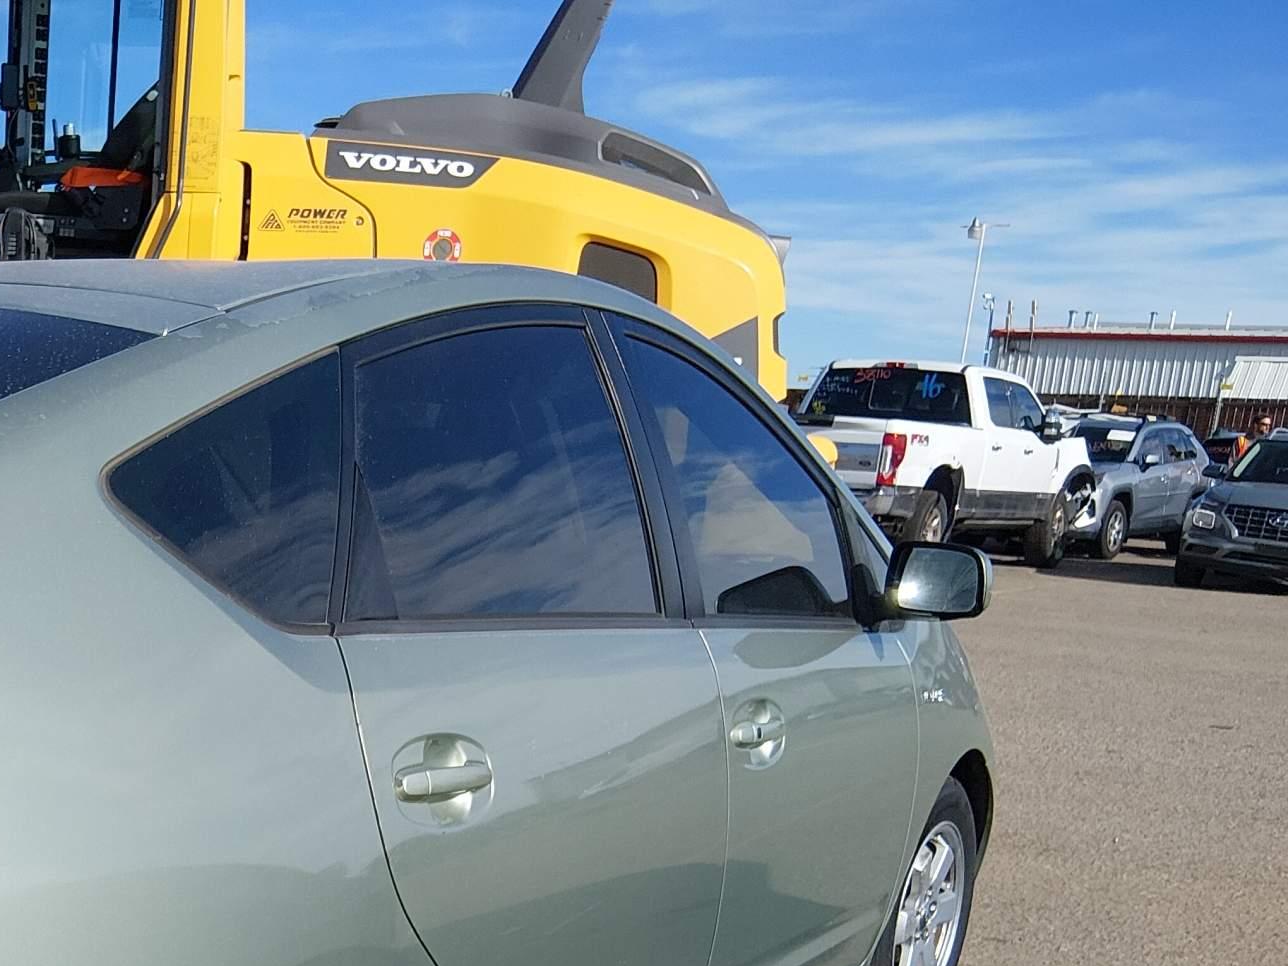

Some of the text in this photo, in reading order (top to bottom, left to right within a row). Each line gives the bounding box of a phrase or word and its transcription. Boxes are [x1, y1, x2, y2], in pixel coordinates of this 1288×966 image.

[339, 151, 474, 178] VOLVO
[287, 208, 347, 219] POWER
[910, 434, 929, 446] FX4
